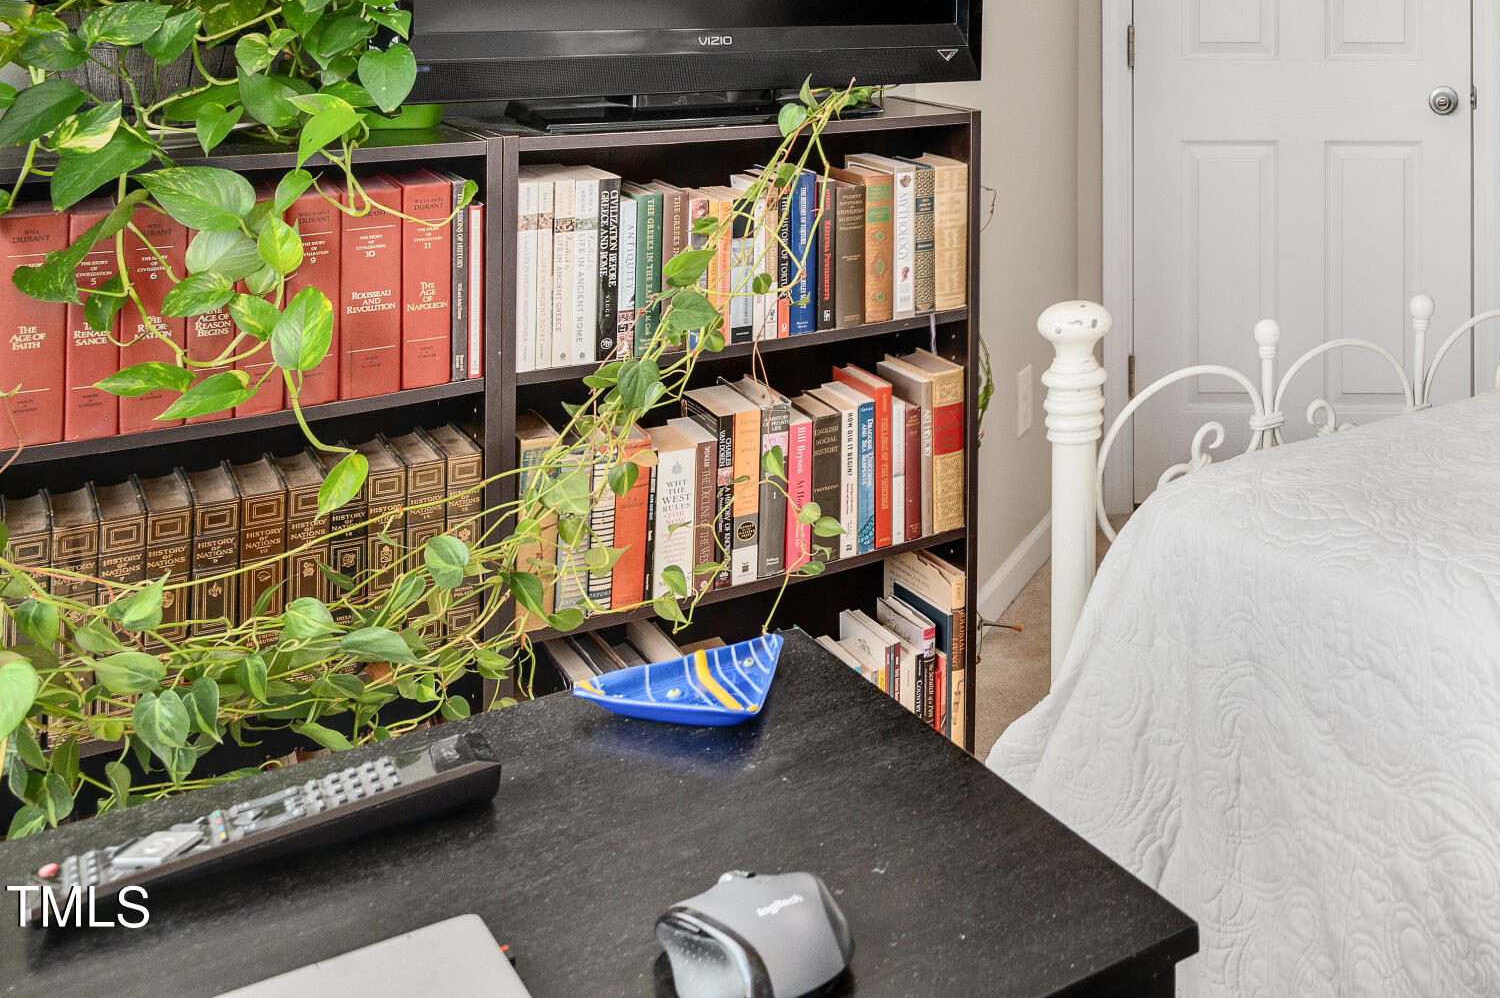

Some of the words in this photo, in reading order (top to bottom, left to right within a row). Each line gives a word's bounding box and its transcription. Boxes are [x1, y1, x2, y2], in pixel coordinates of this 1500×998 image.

[698, 36, 733, 45] VIZIO
[601, 190, 609, 226] GREECE
[781, 194, 789, 212] THE
[837, 206, 864, 216] UNIVERSAL
[609, 189, 618, 250] CIVILIZATION
[838, 214, 864, 222] HISTORY
[898, 192, 909, 261] MYTHOLOGY
[12, 234, 50, 243] DURANT
[600, 229, 608, 250] AND
[647, 217, 655, 251] GREEKS
[578, 234, 586, 253] LIFE
[365, 250, 376, 258] 10
[625, 224, 634, 290] ANTIQUITY
[647, 252, 654, 262] IN
[673, 247, 680, 257] IN
[781, 250, 788, 260] OF
[556, 253, 562, 263] IN
[578, 257, 584, 268] IN
[599, 252, 608, 278] ROME
[608, 253, 617, 288] BEFORE
[646, 263, 654, 281] THE
[91, 278, 97, 286] 5
[420, 282, 435, 290] THE
[352, 289, 391, 300] ROUSSEAU
[419, 289, 435, 297] AGE
[577, 271, 585, 312] ANCIENT
[645, 283, 653, 304] EAST
[423, 295, 433, 303] OF
[346, 303, 396, 314] REVOLUTION
[407, 301, 448, 312] NAPOLEON
[198, 313, 217, 322] AGE
[218, 313, 230, 321] OF
[18, 326, 37, 334] THE
[195, 320, 231, 330] REASON
[10, 333, 32, 343] AGE
[32, 332, 46, 341] OF
[197, 328, 229, 337] BEGINS
[12, 340, 41, 351] FAITH
[76, 337, 108, 347] SANCE
[771, 418, 789, 426] PRIVATE
[923, 408, 932, 426] ART
[797, 426, 806, 444] Bill
[815, 425, 839, 436] ENGLISH
[815, 436, 838, 446] SOCIAL
[848, 442, 854, 450] IT
[922, 425, 931, 458] HISTORY
[814, 445, 839, 456] HISTORY
[704, 445, 712, 468] SPENGLER
[797, 446, 806, 474] Bryson
[881, 452, 888, 462] OF
[860, 453, 868, 486] SERPENTS
[701, 469, 711, 485] THE
[666, 479, 688, 488] WHY
[797, 479, 805, 490] At
[814, 485, 839, 493] TREVELYAN
[667, 487, 687, 495] THE
[411, 494, 443, 505] HISTORY
[448, 497, 480, 508] NATIONS
[662, 493, 692, 504] WEST
[701, 485, 711, 521] DECLINE
[410, 504, 442, 515] NATIONS
[662, 502, 691, 513] RULES
[332, 511, 366, 522] HISTORY
[292, 518, 327, 530] HISTORY
[725, 522, 731, 532] OF
[246, 527, 283, 539] HISTORY
[291, 529, 326, 540] NATIONS
[198, 537, 236, 549] HISTORY
[245, 537, 281, 549] NATIONS
[701, 532, 709, 547] THE
[149, 546, 188, 558] HISTORY
[196, 548, 234, 560] NATIONS
[103, 554, 142, 566] HISTORY
[148, 557, 186, 569] NATIONS
[101, 564, 141, 577] NATIONS
[951, 637, 959, 667] LIVING
[915, 679, 924, 713] COUNTRY
[756, 894, 804, 917] logitech
